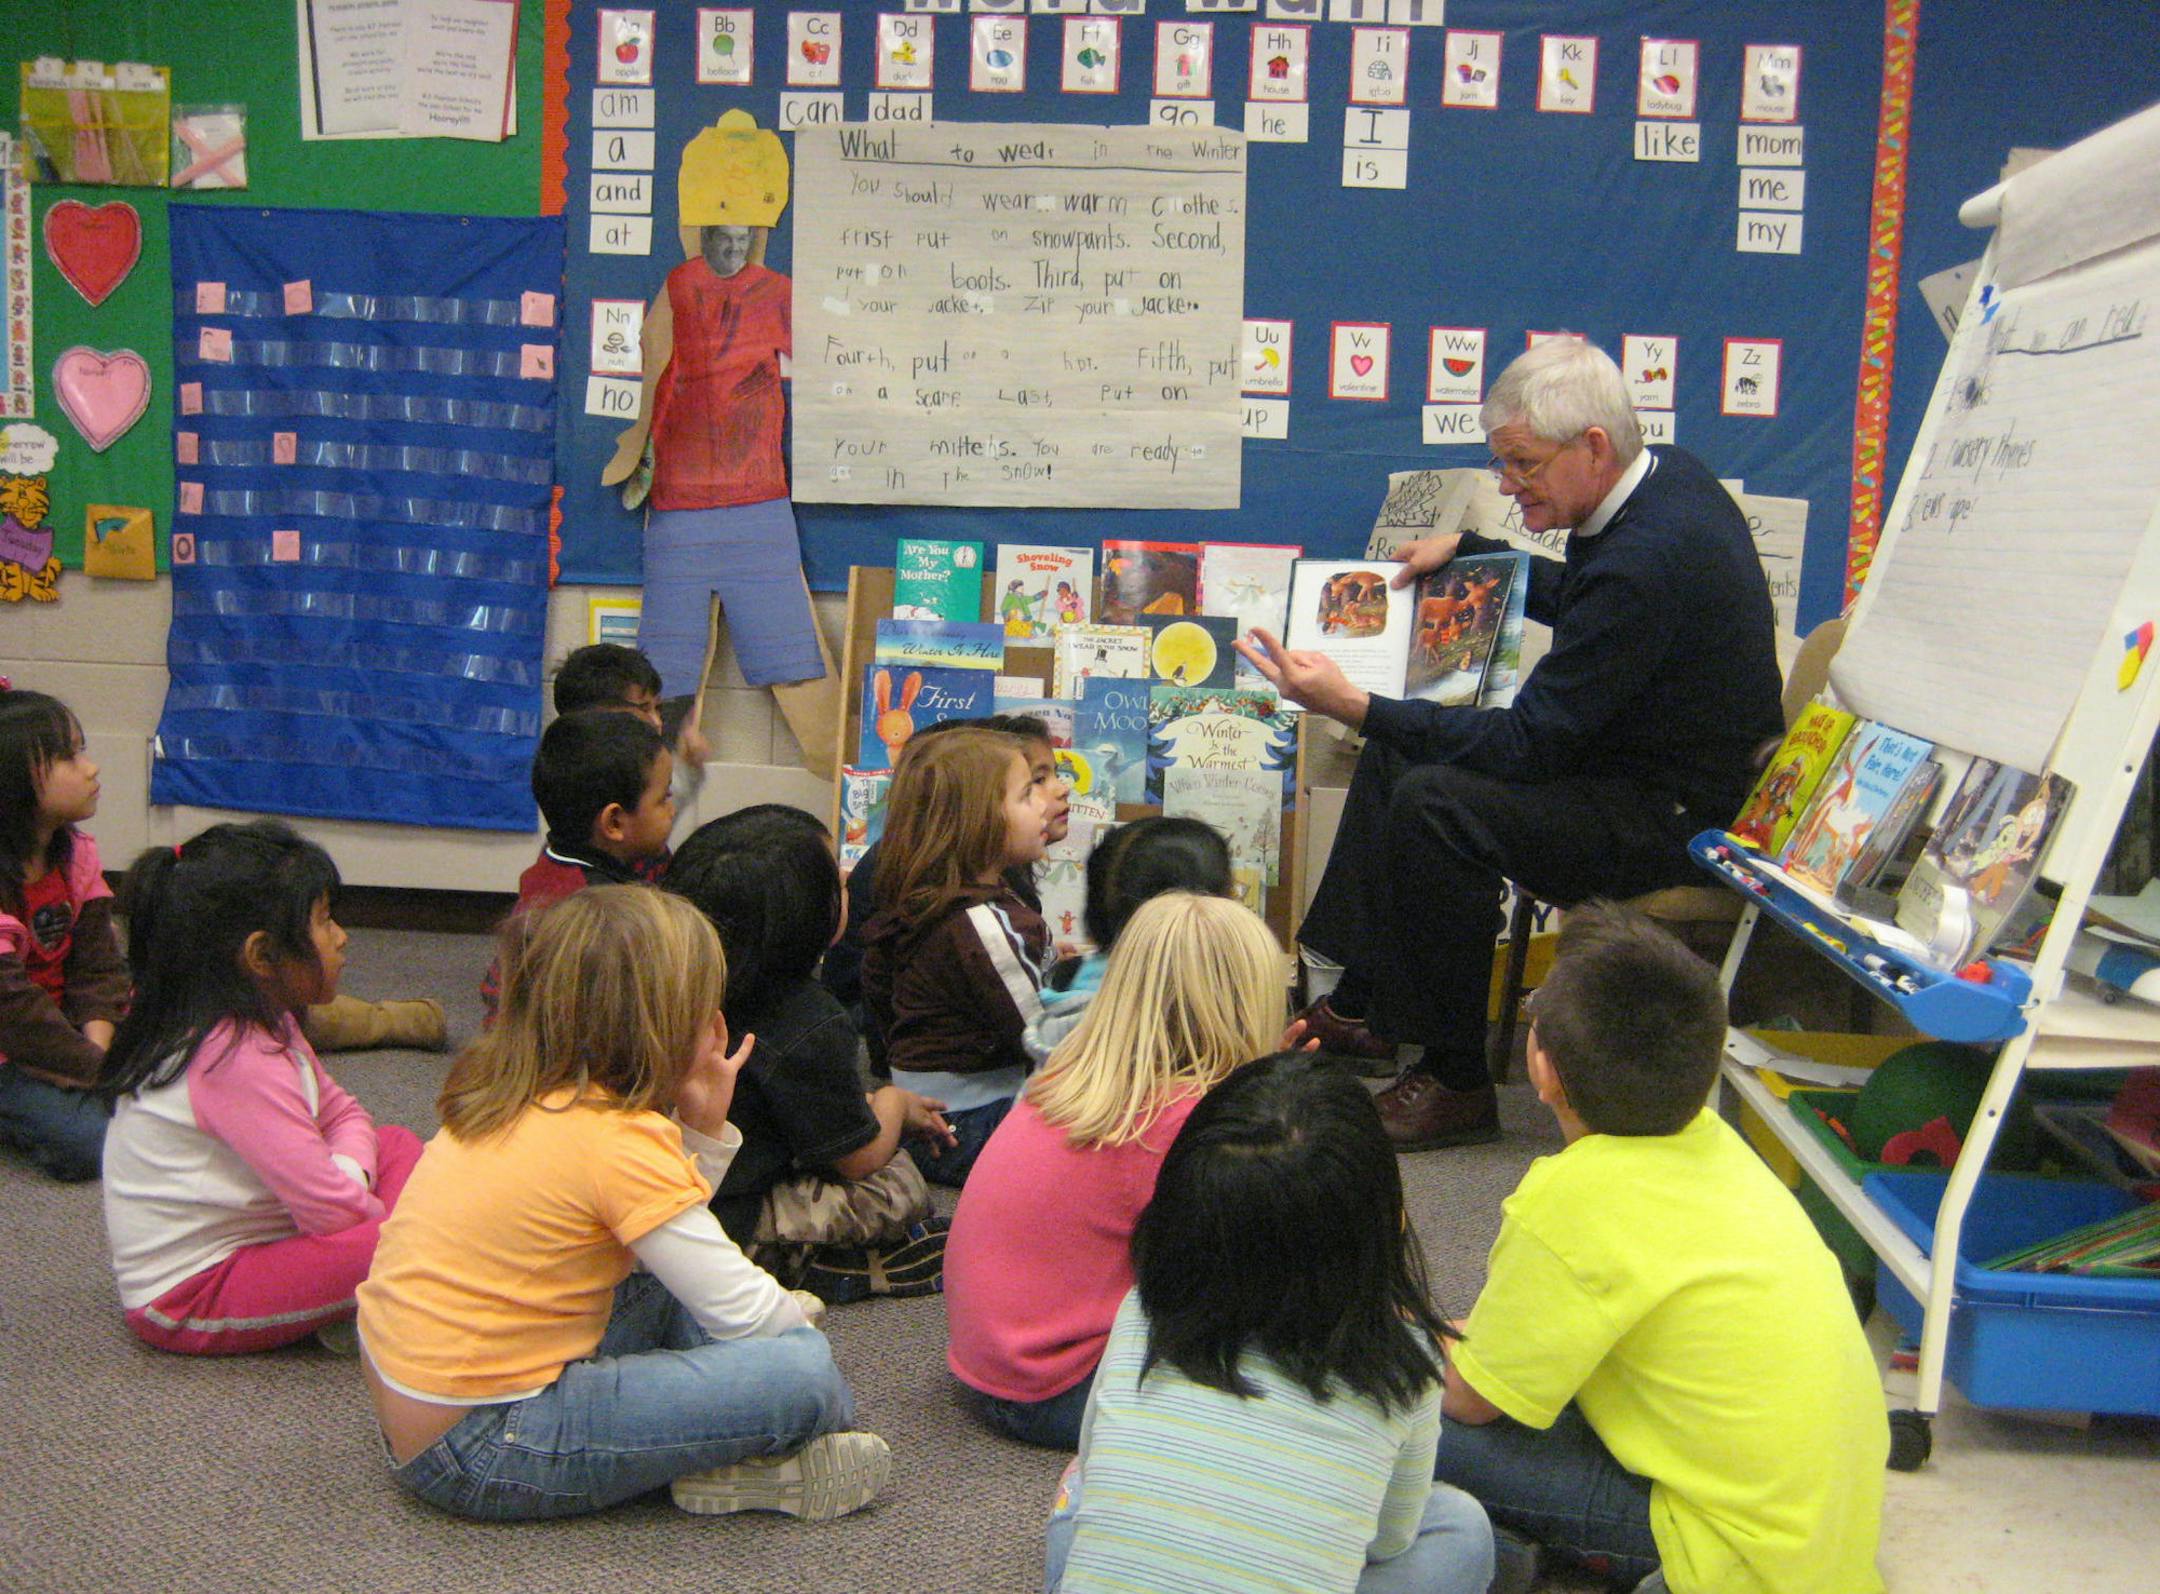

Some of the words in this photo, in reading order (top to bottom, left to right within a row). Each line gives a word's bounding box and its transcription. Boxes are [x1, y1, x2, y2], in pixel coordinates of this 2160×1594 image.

[715, 16, 735, 32] Bb
[807, 17, 830, 35] Cc
[894, 20, 917, 37] Dd
[993, 24, 1012, 40] Ee
[1081, 25, 1101, 41] Ff
[1174, 29, 1200, 48] Gg
[1268, 33, 1291, 49] Hh
[1467, 43, 1478, 60] Jj
[1562, 43, 1582, 61] Kk
[1660, 48, 1677, 66] Ll
[1757, 53, 1791, 69] Mm
[1177, 80, 1191, 90] gift
[1263, 85, 1289, 95] house
[602, 92, 638, 118] am
[786, 99, 839, 126] can
[875, 95, 922, 121] dad
[1647, 100, 1682, 112] ladybug
[1261, 109, 1286, 135] he
[1359, 110, 1383, 143] I
[608, 136, 625, 162] a
[839, 129, 895, 159] What
[951, 143, 974, 163] to
[1094, 140, 1107, 160] in
[1192, 137, 1241, 160] Winter
[1644, 125, 1696, 157] like
[1746, 133, 1801, 154] mom
[1356, 156, 1378, 181] is
[596, 178, 641, 201] and
[1749, 178, 1789, 200] me
[983, 193, 1032, 213] wear
[1064, 193, 1127, 217] warm
[606, 224, 632, 246] at
[1032, 223, 1131, 254] snowpants.
[1152, 221, 1226, 256] Second,
[1748, 221, 1787, 250] my
[951, 262, 1012, 291] boots.
[1034, 260, 1084, 291] Third,
[1105, 270, 1139, 296] put
[1159, 270, 1182, 290] on
[606, 308, 631, 325] Nn
[1075, 300, 1114, 324] your
[1256, 327, 1279, 343] Uu
[1351, 332, 1371, 348] Vv
[1445, 335, 1478, 352] Ww
[1643, 342, 1663, 363] Yy
[1742, 349, 1760, 366] Zz
[912, 339, 950, 380] put
[1137, 339, 1192, 375] Fifth,
[1208, 344, 1239, 385] put
[1245, 376, 1284, 387] umbrella
[1340, 382, 1377, 393] valentine
[601, 384, 633, 412] no
[878, 386, 888, 400] a
[1162, 385, 1188, 401] on
[1737, 401, 1760, 409] zebra
[1434, 413, 1475, 434] we
[1130, 434, 1178, 474] ready
[904, 544, 926, 555] Are
[929, 543, 950, 555] You
[919, 556, 938, 570] My
[1016, 552, 1073, 567] Shoveling
[1030, 562, 1059, 572] Snow
[901, 568, 951, 582] Mother?
[917, 685, 976, 710] First
[1186, 719, 1252, 741] Winter
[1223, 744, 1237, 756] the
[1187, 752, 1257, 770] Warmest
